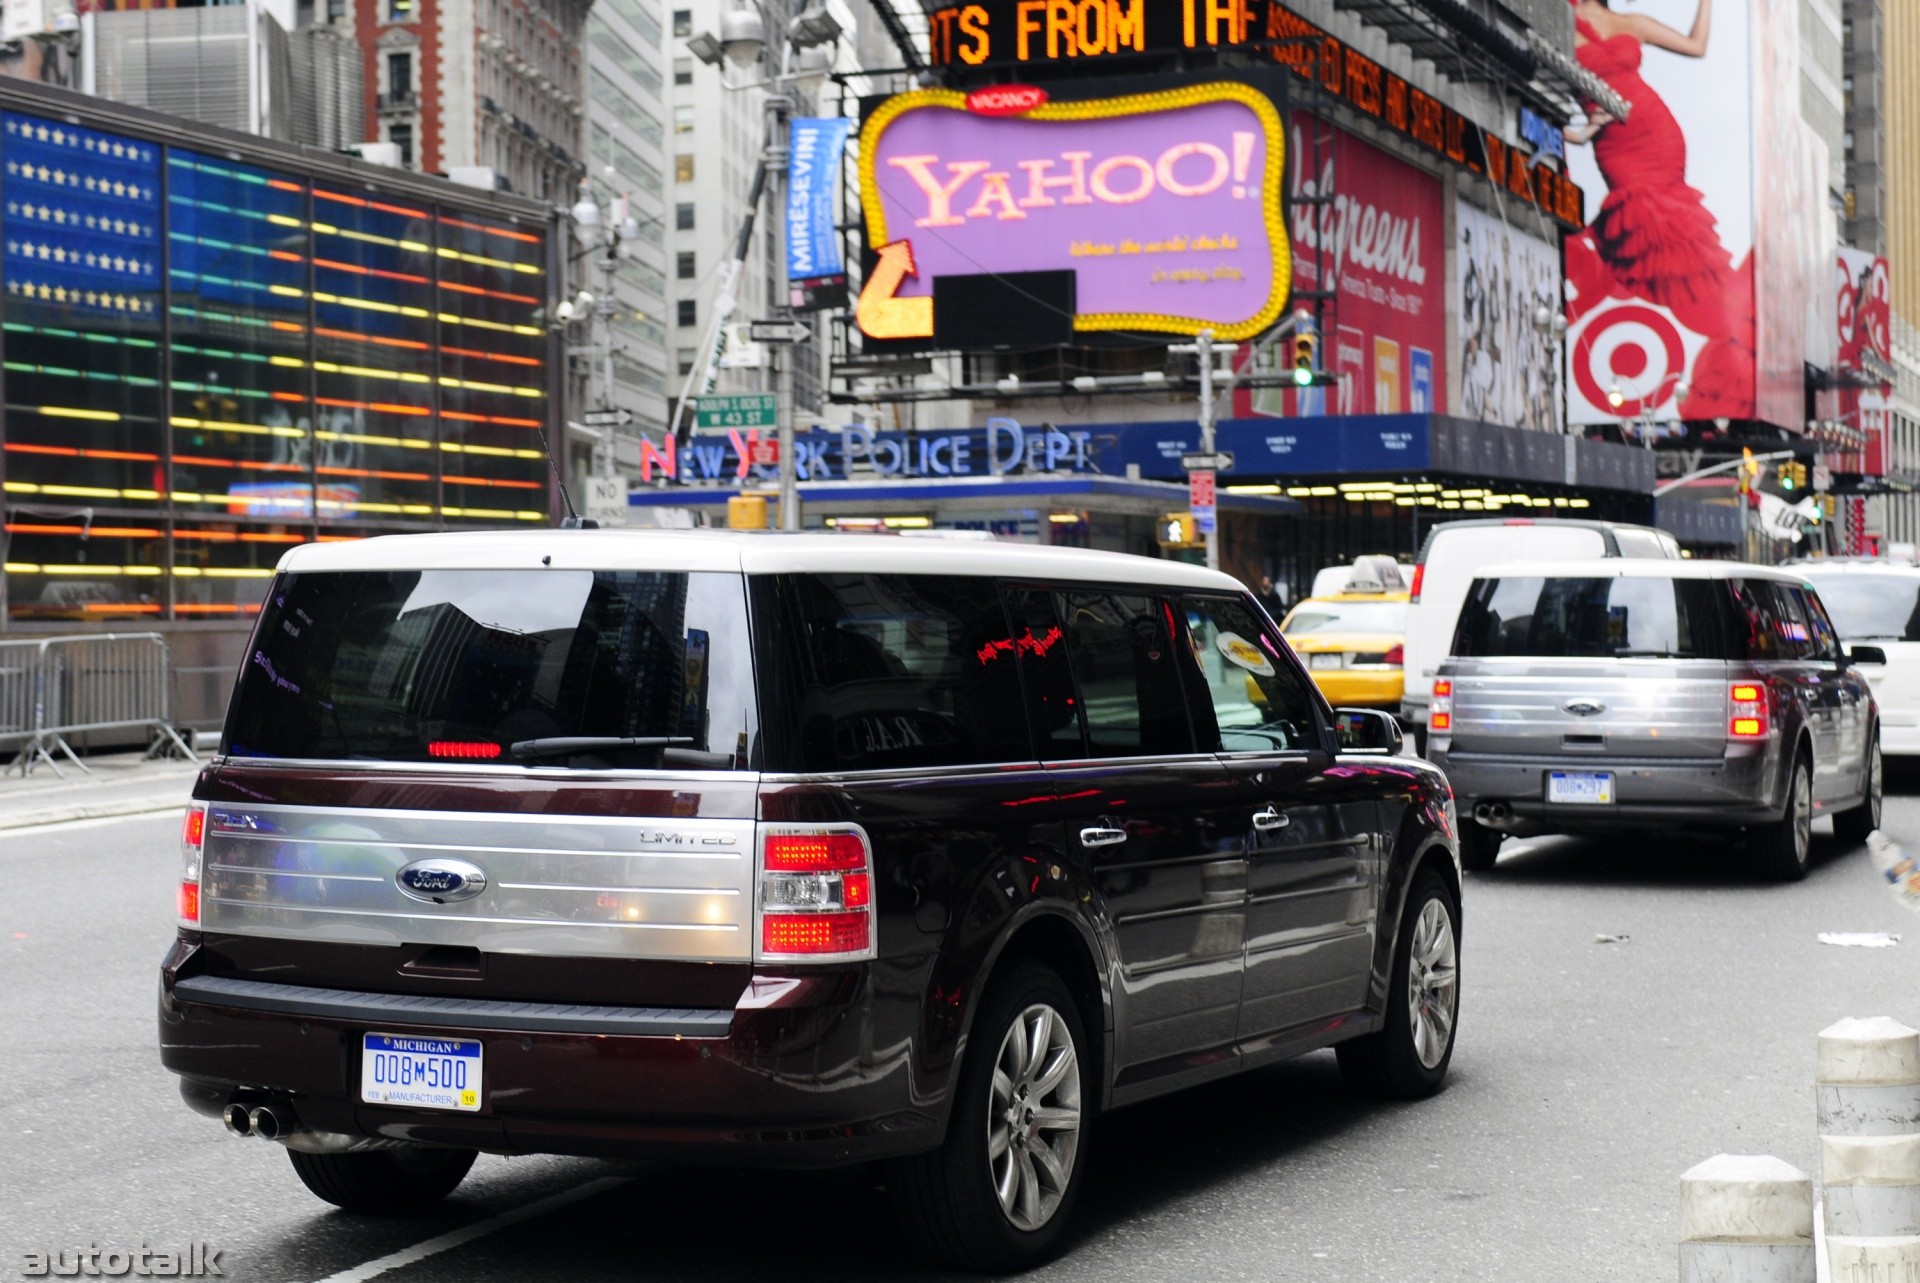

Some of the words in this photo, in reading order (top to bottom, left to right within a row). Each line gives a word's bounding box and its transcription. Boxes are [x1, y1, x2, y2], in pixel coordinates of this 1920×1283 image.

[1016, 0, 1144, 60] FROM
[887, 131, 1256, 228] YAHOO!
[639, 429, 725, 483] NEW
[841, 423, 972, 475] POLICE
[987, 416, 1092, 477] DEPT
[596, 483, 617, 499] NO
[640, 829, 738, 846] LIMITED
[413, 868, 452, 889] Ford
[393, 1039, 452, 1054] MICHIGAN
[374, 1053, 466, 1090] 008M500
[368, 1090, 380, 1099] FEB
[388, 1091, 452, 1106] MANUFACTURER
[464, 1095, 475, 1103] 10
